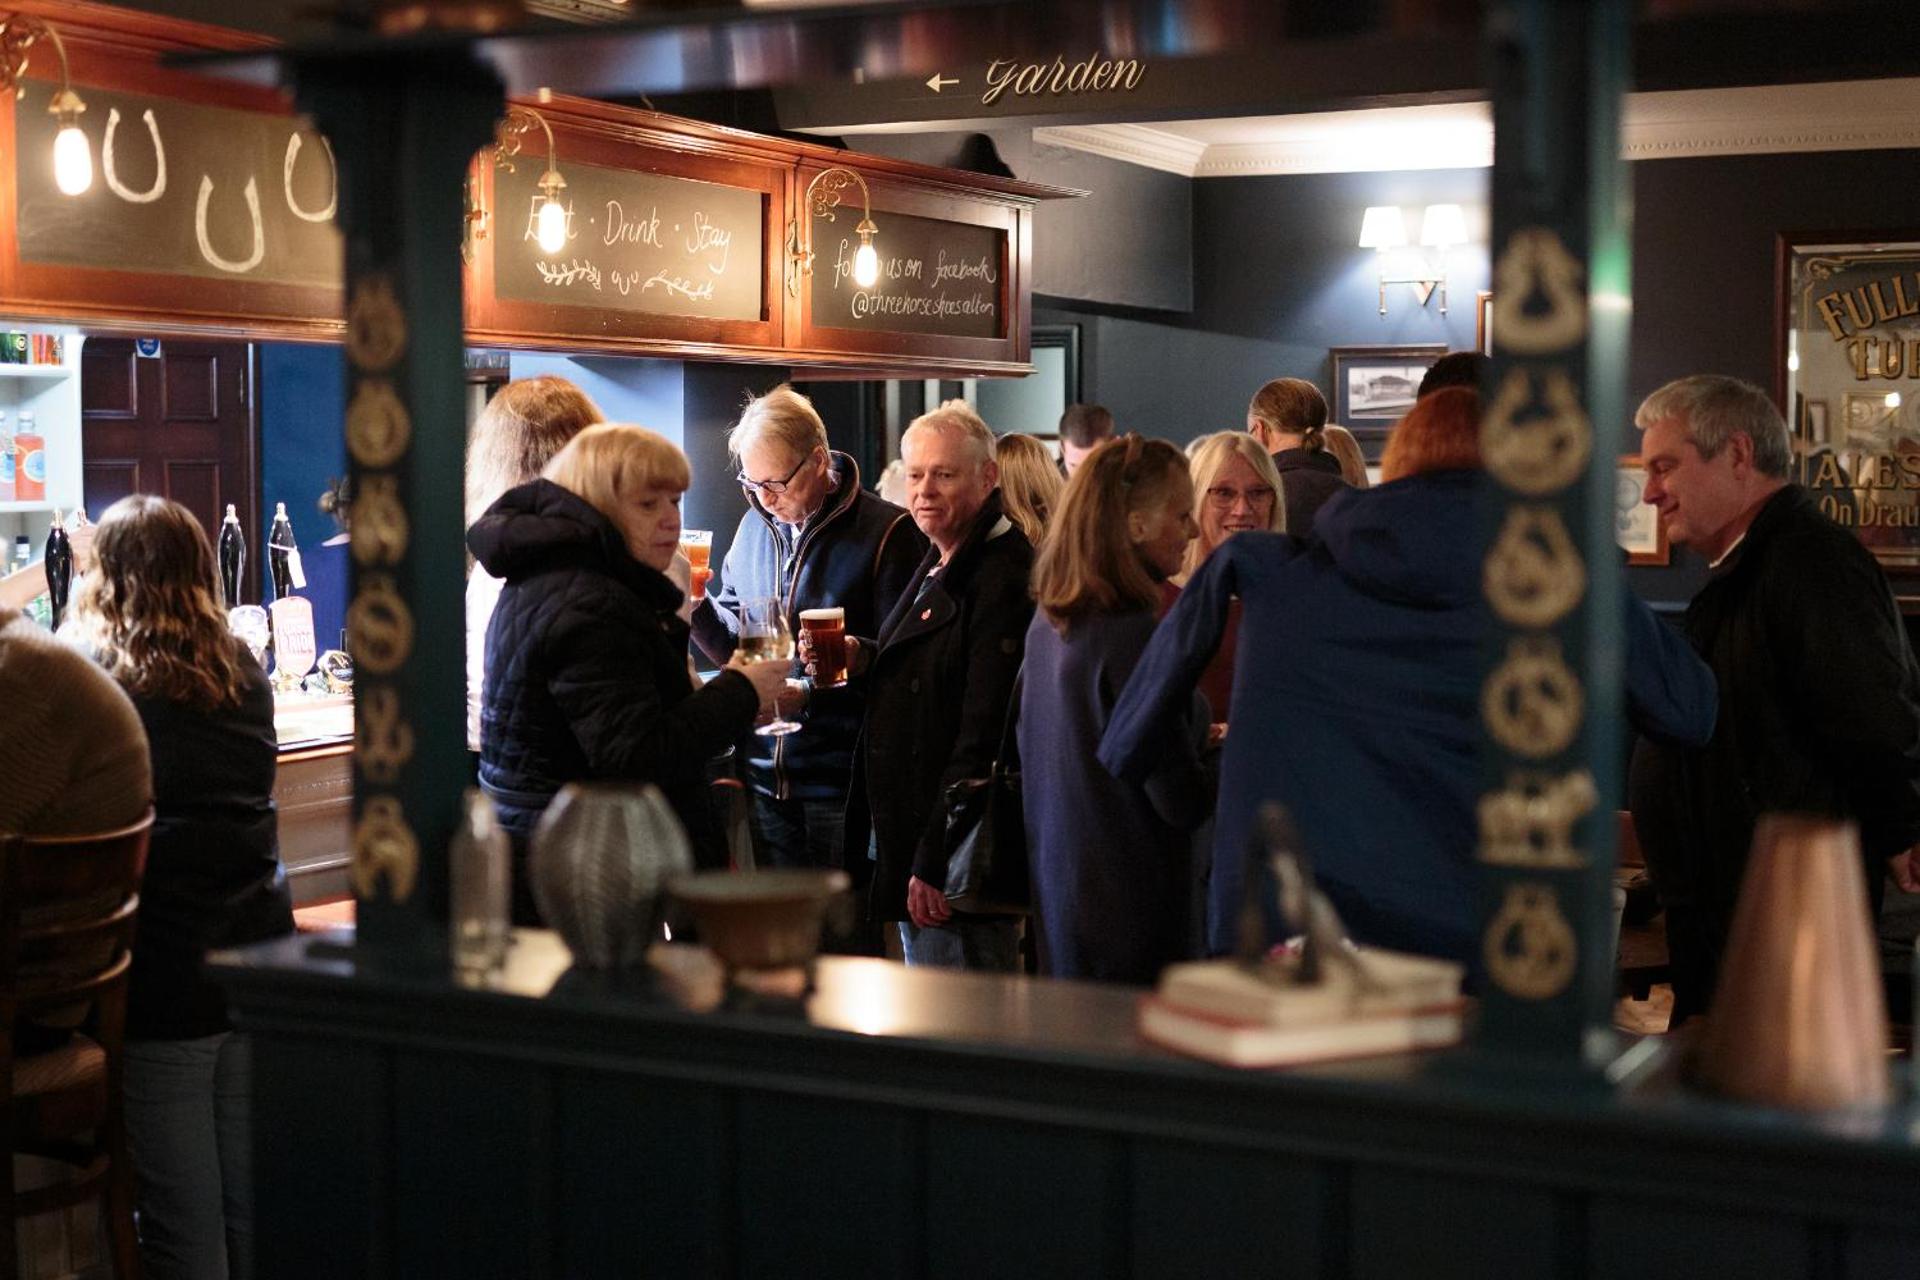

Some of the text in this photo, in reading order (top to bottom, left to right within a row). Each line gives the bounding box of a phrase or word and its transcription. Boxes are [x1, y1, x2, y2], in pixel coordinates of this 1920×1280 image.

[524, 195, 732, 275] Et Drink Stay
[932, 249, 997, 288] facebook
[1816, 272, 1920, 340] FULL
[1811, 453, 1920, 490] ALES
[1821, 494, 1853, 526] On
